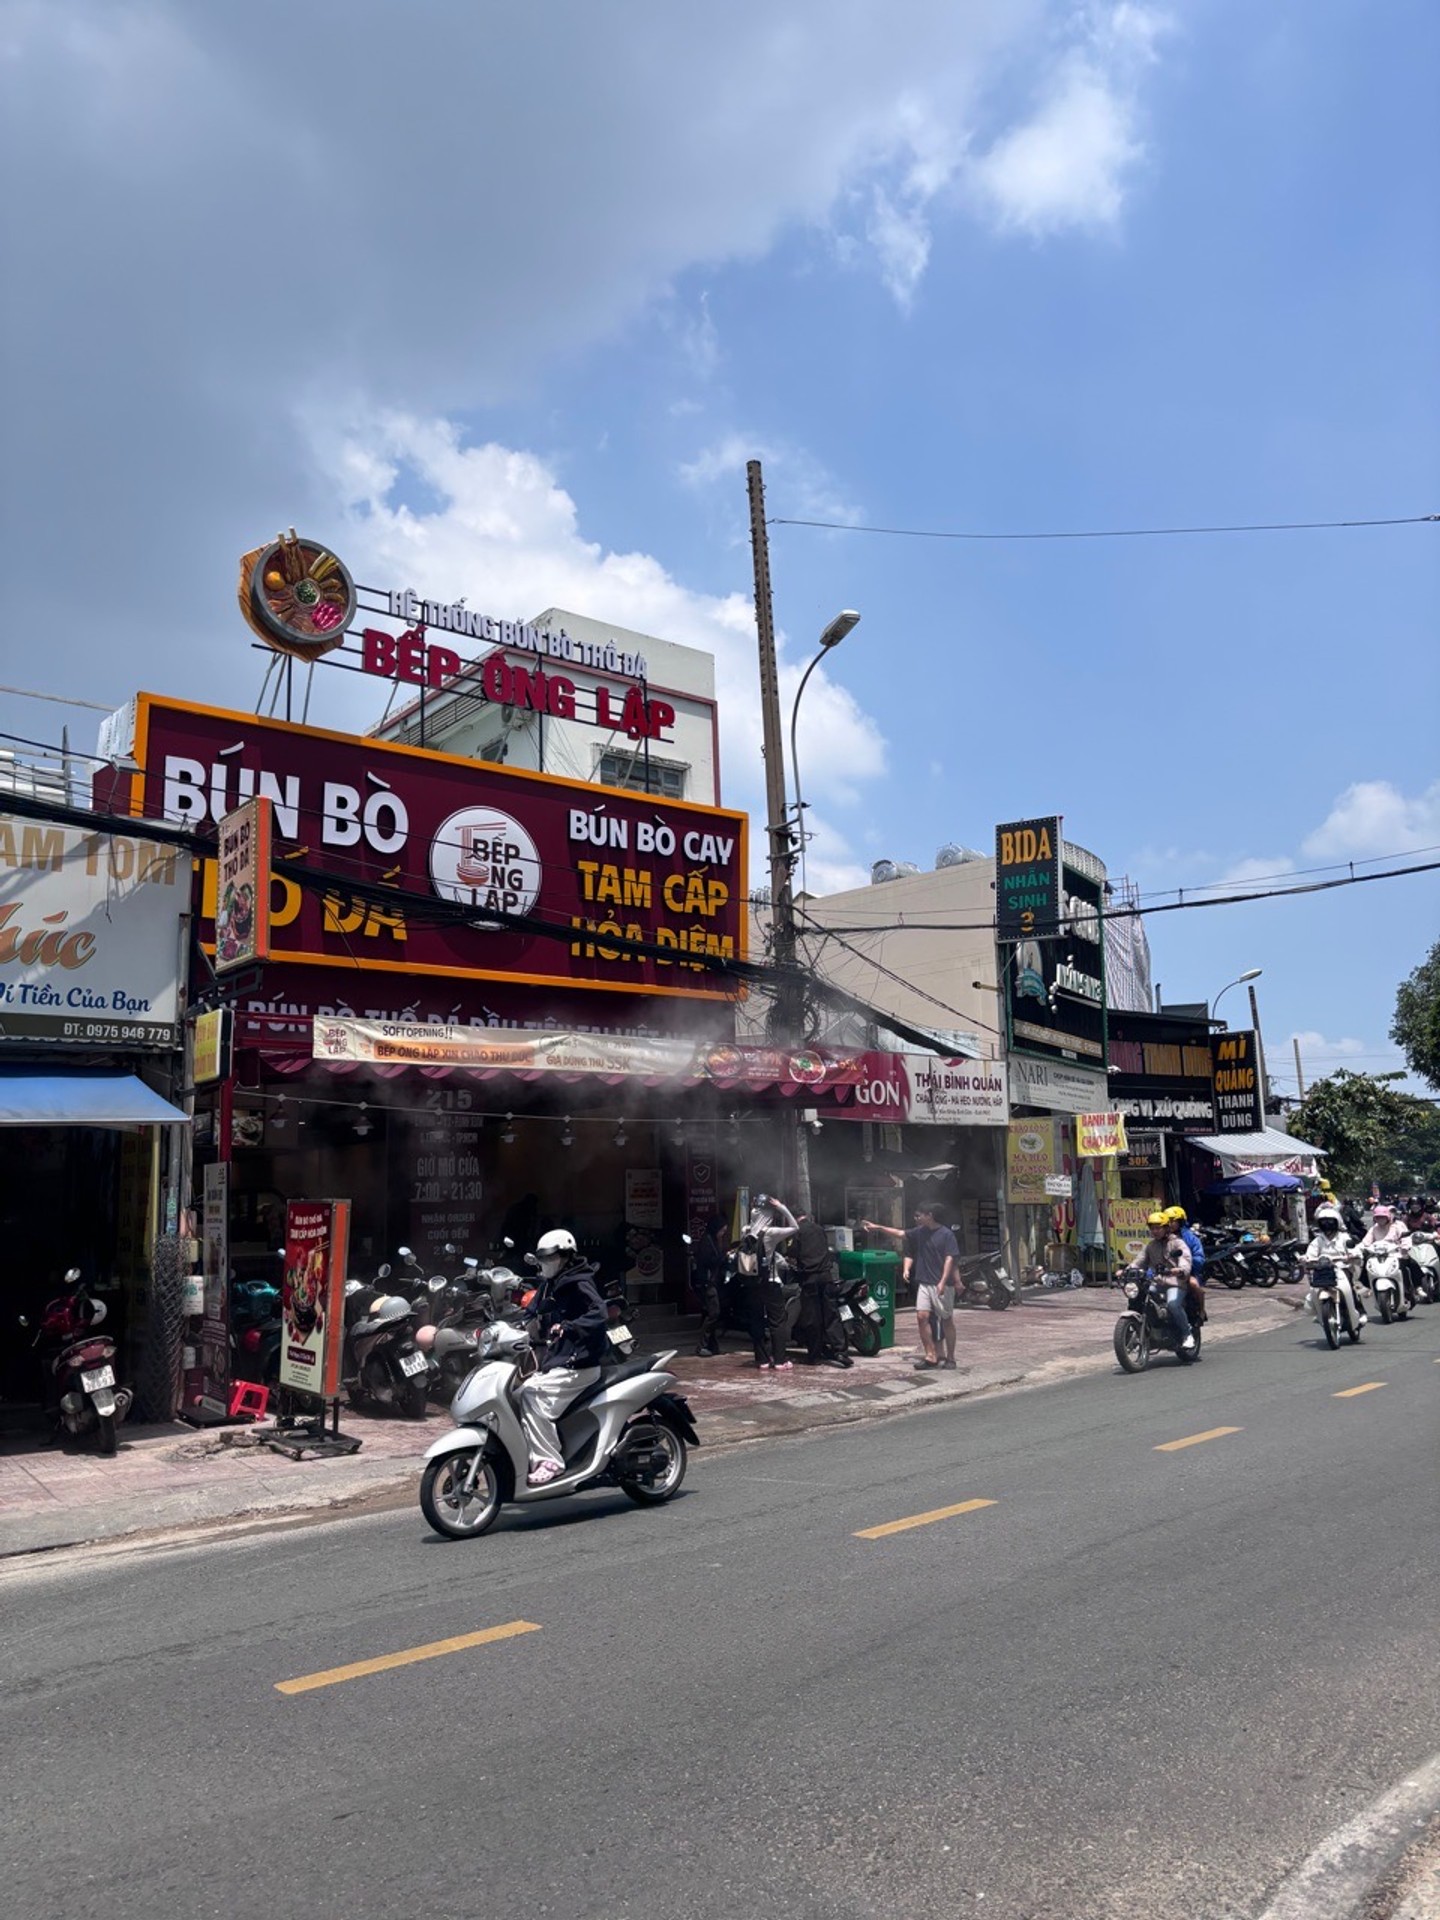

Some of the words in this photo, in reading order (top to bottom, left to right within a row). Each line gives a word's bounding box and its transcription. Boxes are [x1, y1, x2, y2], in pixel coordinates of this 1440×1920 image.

[389, 588, 419, 627] HỆ
[424, 597, 495, 640] THỐNG
[501, 617, 548, 652] BÚN
[551, 629, 573, 660] BÒ
[580, 638, 623, 672] THỐ
[624, 651, 648, 679] ĐÁ
[363, 624, 460, 688] BẾP
[481, 652, 575, 719] ÔNG
[596, 684, 675, 740] LẬP
[163, 741, 300, 839] BÚN
[323, 771, 409, 854] BÒ
[473, 833, 520, 865] BẾP
[569, 804, 628, 848] BÚN
[637, 814, 676, 856] BÒ
[684, 831, 734, 865] CAY
[1001, 827, 1052, 865] BIDA
[578, 861, 652, 908] TAM
[663, 865, 729, 916] CẤP
[1008, 893, 1047, 911] SINH
[571, 909, 647, 963] HỎA
[19, 984, 63, 1006] Tiền
[67, 988, 108, 1009] Của
[113, 991, 152, 1014] Bạn
[64, 1023, 83, 1036] ĐT:
[87, 1024, 118, 1037] 0975
[122, 1026, 145, 1039] 946
[148, 1028, 171, 1041] 779
[1218, 1035, 1246, 1060] MÌ
[915, 1072, 941, 1089] THÁI
[945, 1074, 969, 1089] BÌNH
[972, 1074, 1002, 1091] QUÁN
[1215, 1062, 1254, 1093] QUẢNG
[426, 1089, 472, 1109] 215
[1218, 1094, 1254, 1110] THANH
[1221, 1111, 1252, 1129] DŨNG
[415, 1182, 440, 1200] 7:00
[451, 1181, 483, 1200] 21:30
